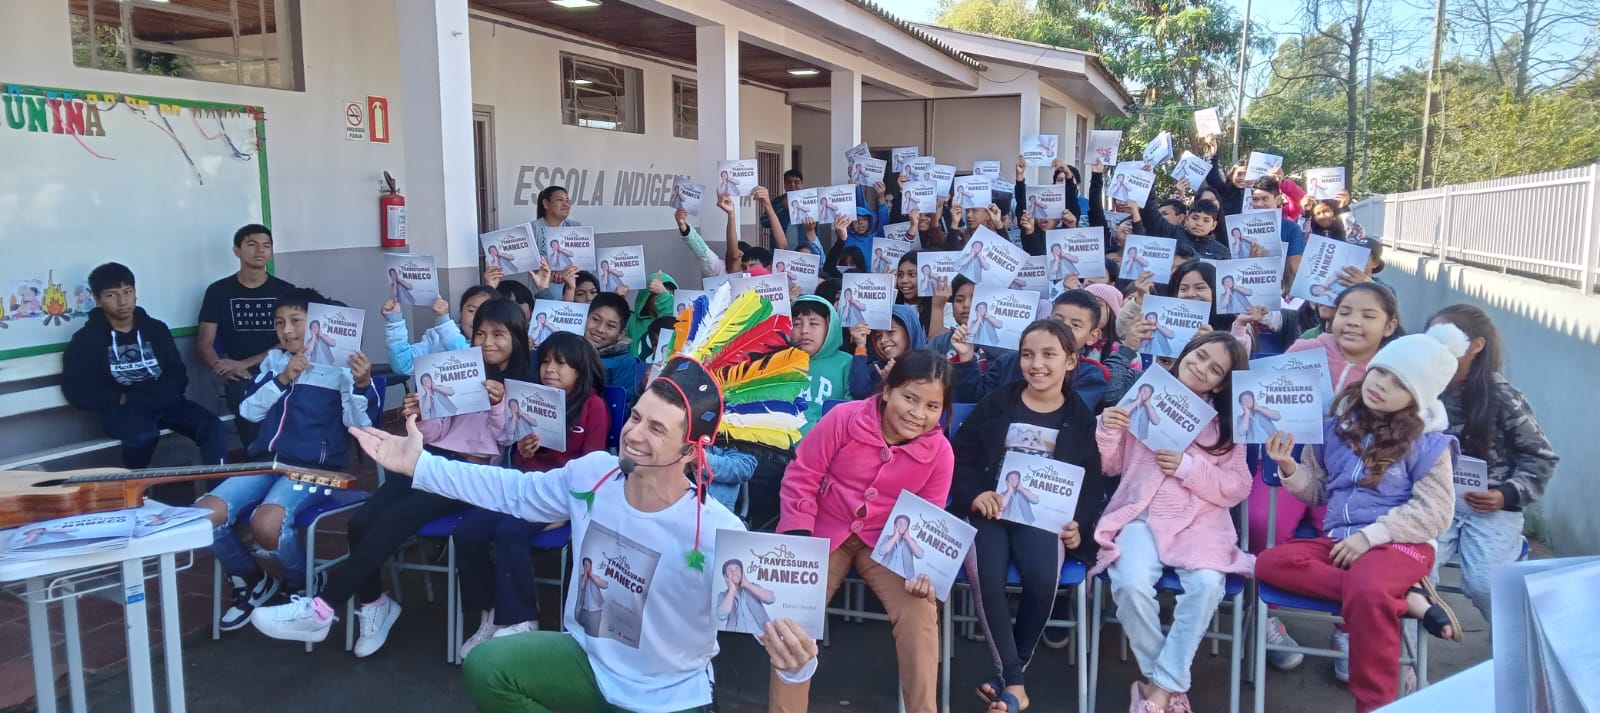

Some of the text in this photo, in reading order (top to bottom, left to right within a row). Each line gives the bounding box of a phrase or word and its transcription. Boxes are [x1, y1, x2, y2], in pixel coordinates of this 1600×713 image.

[613, 164, 691, 207] INDÍGE
[503, 242, 528, 251] MANECO
[1068, 244, 1099, 252] MANECO
[1142, 250, 1170, 259] MANECO
[1318, 243, 1336, 278] MANECO
[615, 260, 639, 268] MANECO
[986, 252, 1015, 272] MANECO
[403, 272, 431, 280] MANECO
[790, 265, 815, 274] MANECO
[1242, 275, 1276, 284] MANECO
[994, 308, 1030, 319] MANECO
[553, 317, 582, 325] MANECO
[1165, 317, 1202, 329] MANECO
[327, 322, 357, 337] MANECO
[439, 362, 477, 372] TRAVESSURAS
[441, 368, 478, 382] MANECO
[797, 376, 833, 406] AP
[1265, 393, 1313, 404] MANECO
[527, 404, 557, 419] MANECO
[1163, 392, 1201, 425] TRAVESSURAS
[1156, 401, 1195, 433] MANECO
[1031, 470, 1074, 487] TRAVESSURAS
[1453, 477, 1481, 487] NECO
[1029, 478, 1073, 497] MANECO
[922, 521, 963, 549] TRAVESSURAS
[916, 530, 958, 560] MANECO
[758, 555, 819, 569] TRAVESSURAS
[607, 558, 646, 585] TRAVESSURAS
[757, 565, 819, 585] MANECO
[604, 567, 644, 594] MANECO
